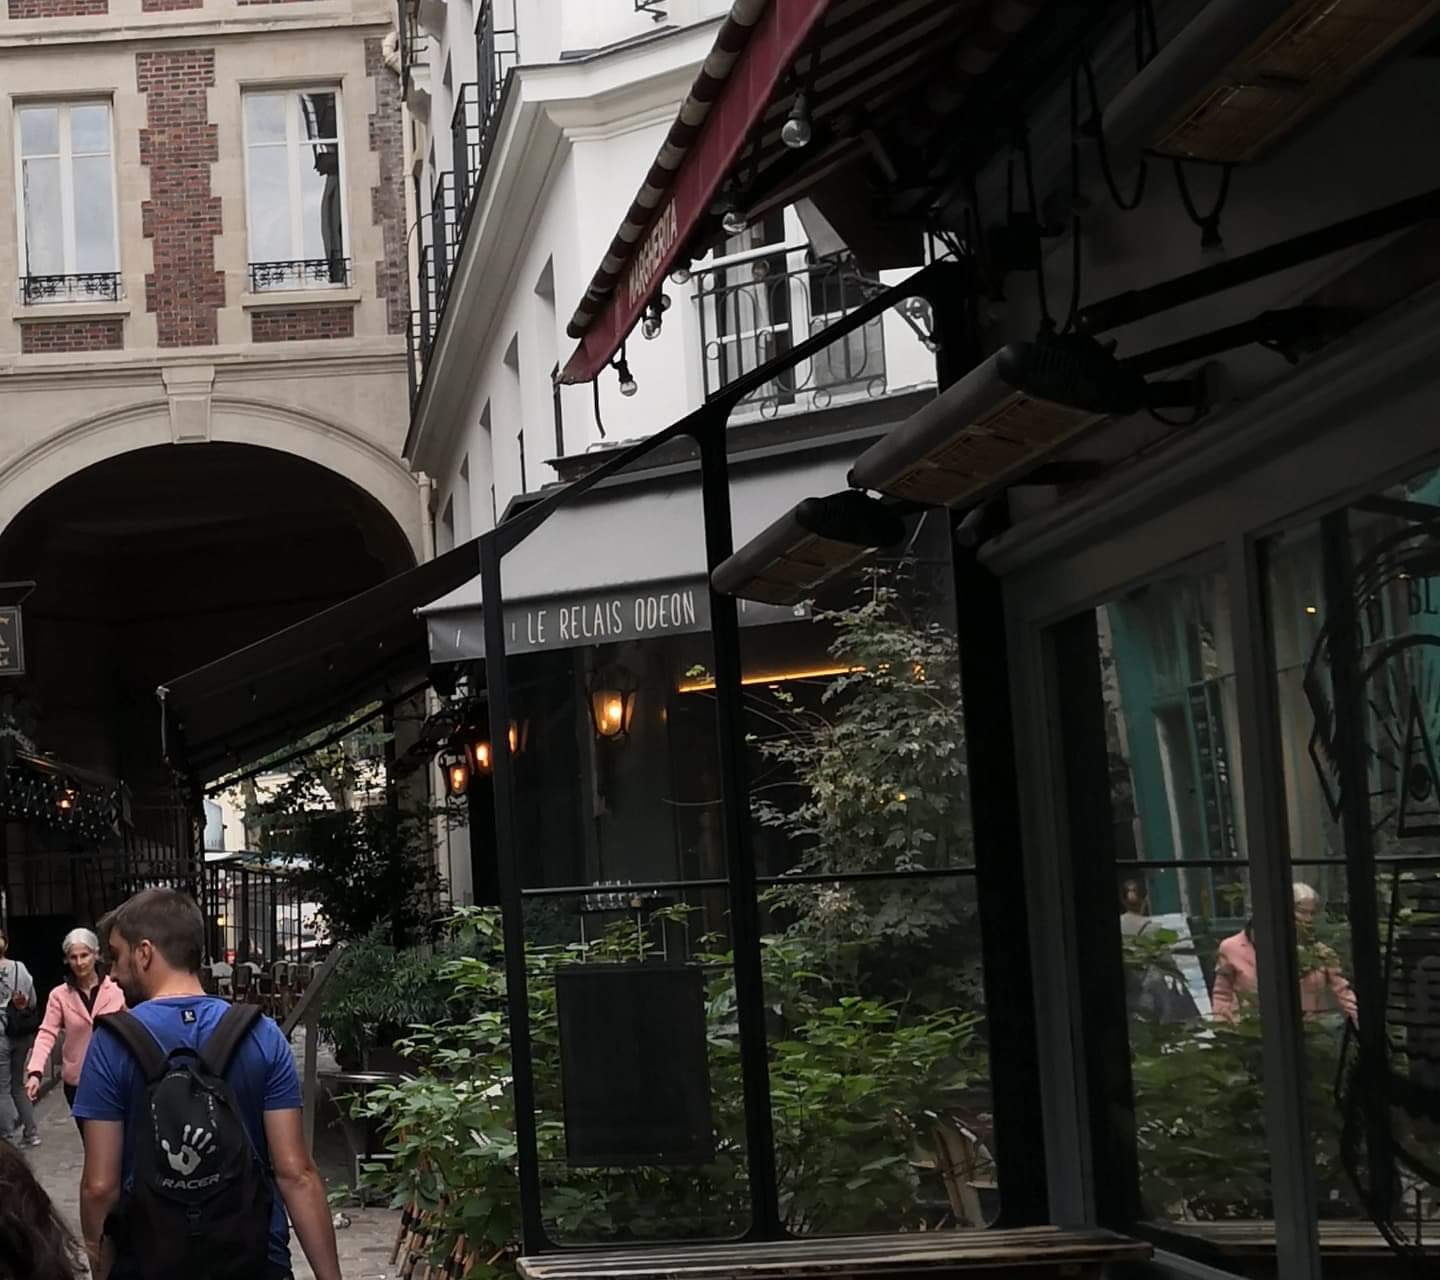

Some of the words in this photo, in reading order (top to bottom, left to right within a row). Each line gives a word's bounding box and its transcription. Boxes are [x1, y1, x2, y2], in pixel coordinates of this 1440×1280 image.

[527, 610, 548, 644] LE
[559, 600, 623, 641] RELAIS
[634, 590, 697, 632] ODEON
[162, 1173, 220, 1189] RACER
